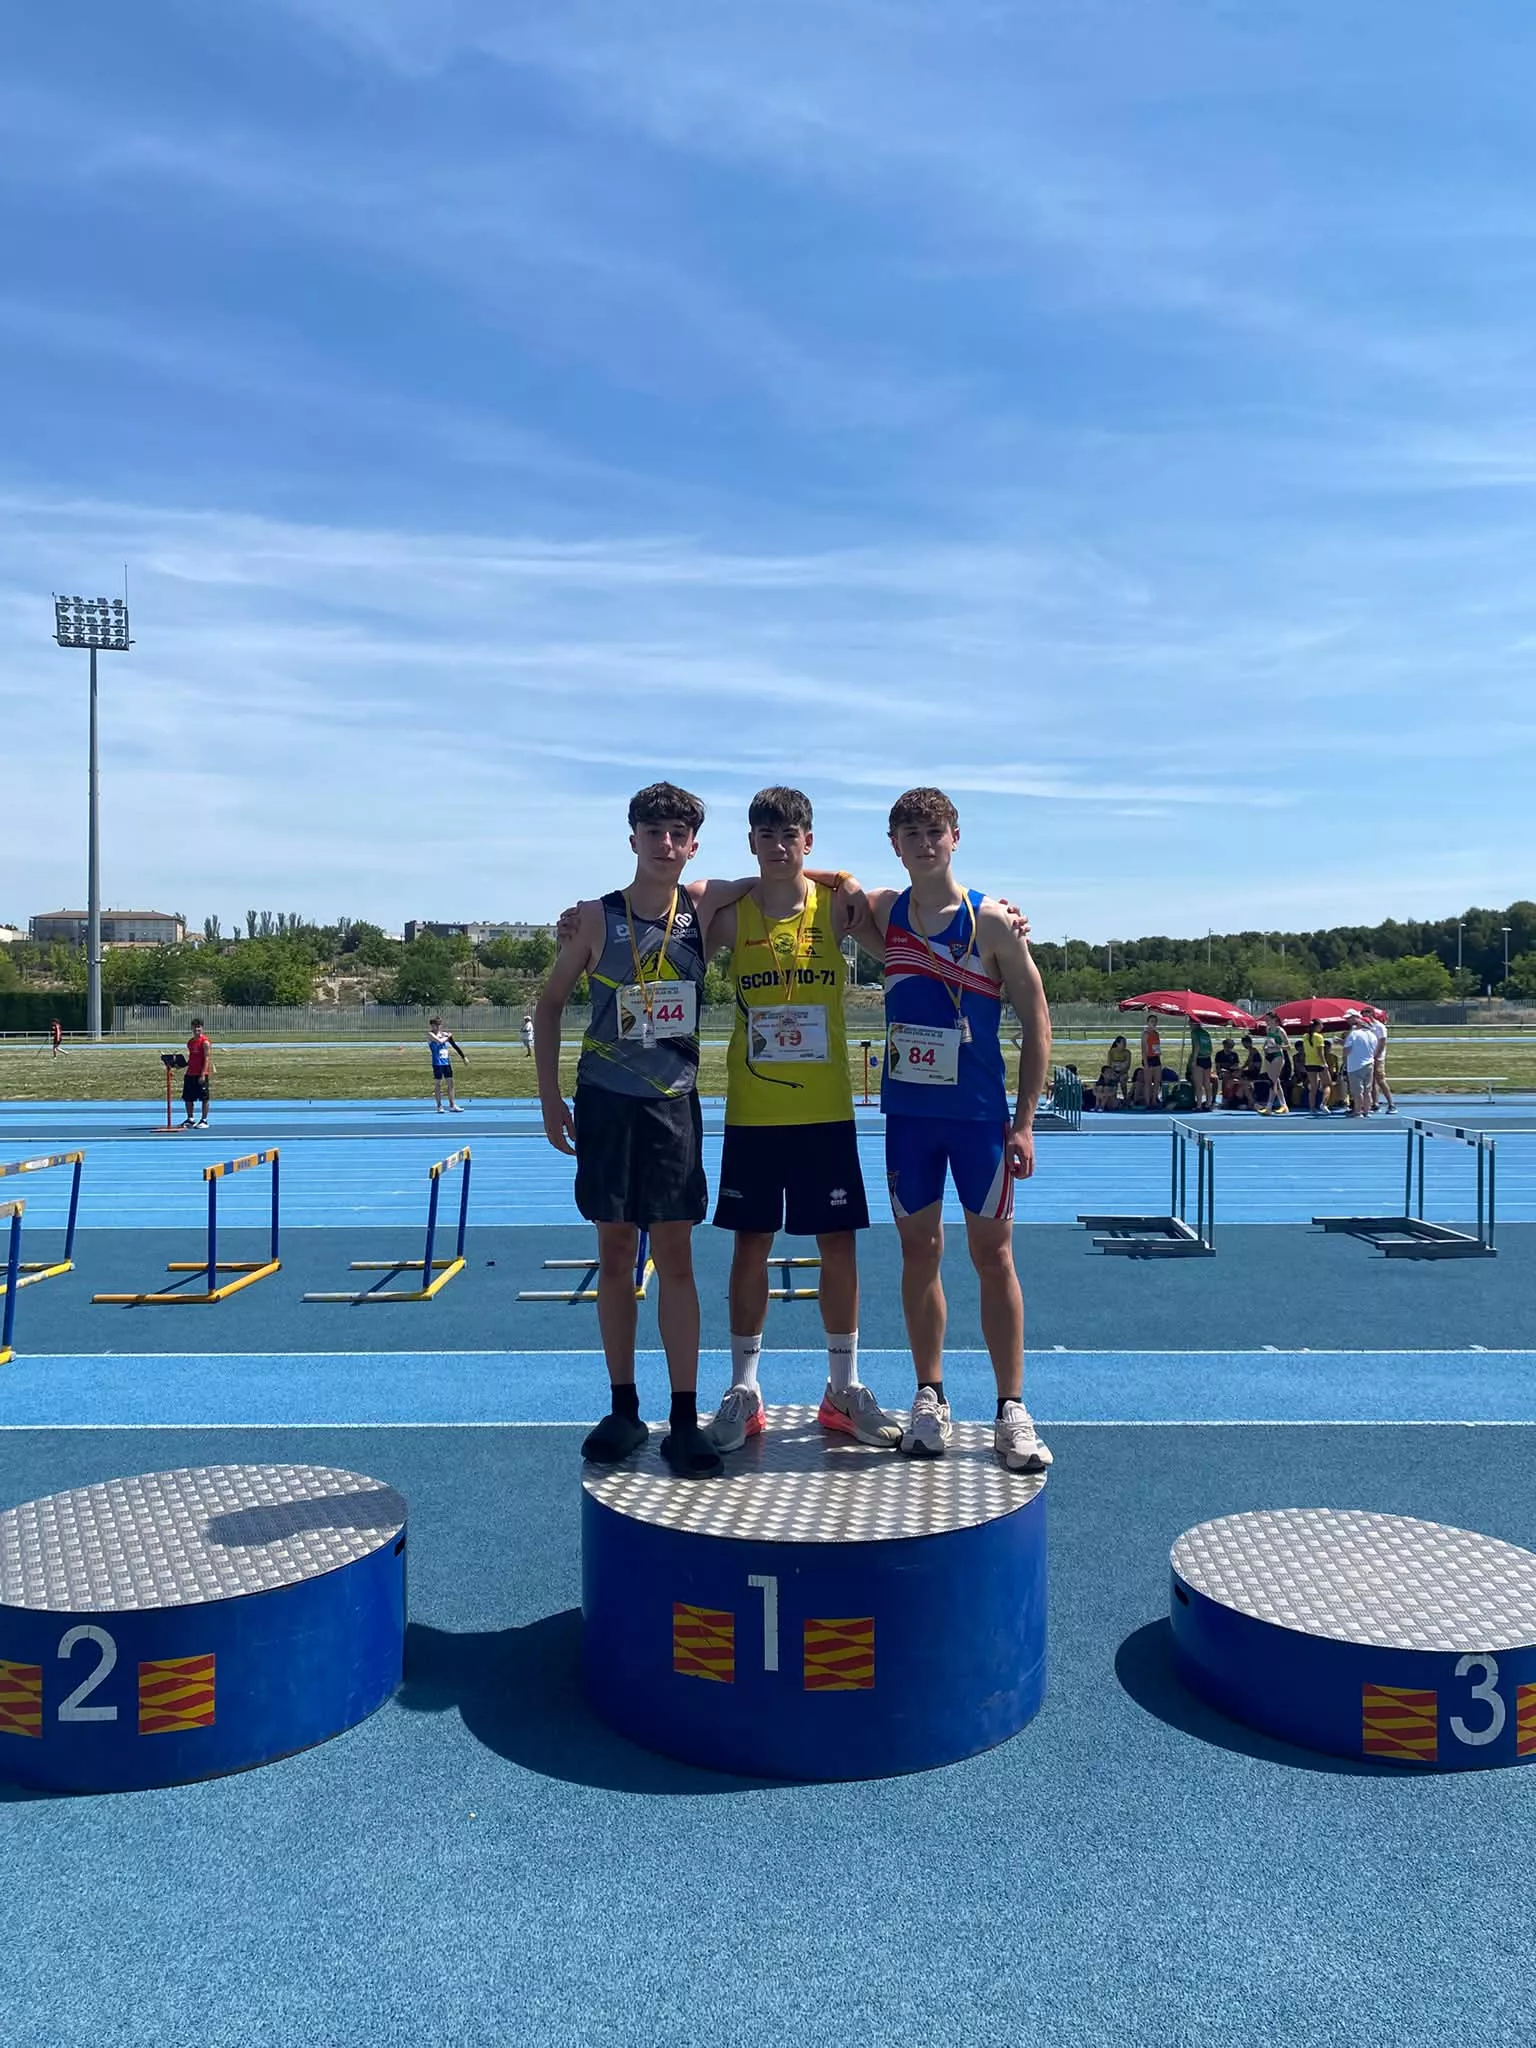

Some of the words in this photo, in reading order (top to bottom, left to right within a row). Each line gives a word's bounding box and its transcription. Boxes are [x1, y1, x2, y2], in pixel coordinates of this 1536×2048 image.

[775, 1030, 802, 1047] 19
[908, 1046, 936, 1067] 84
[748, 1574, 779, 1672] 1
[57, 1624, 118, 1722] 2
[1449, 1652, 1506, 1746] 3
